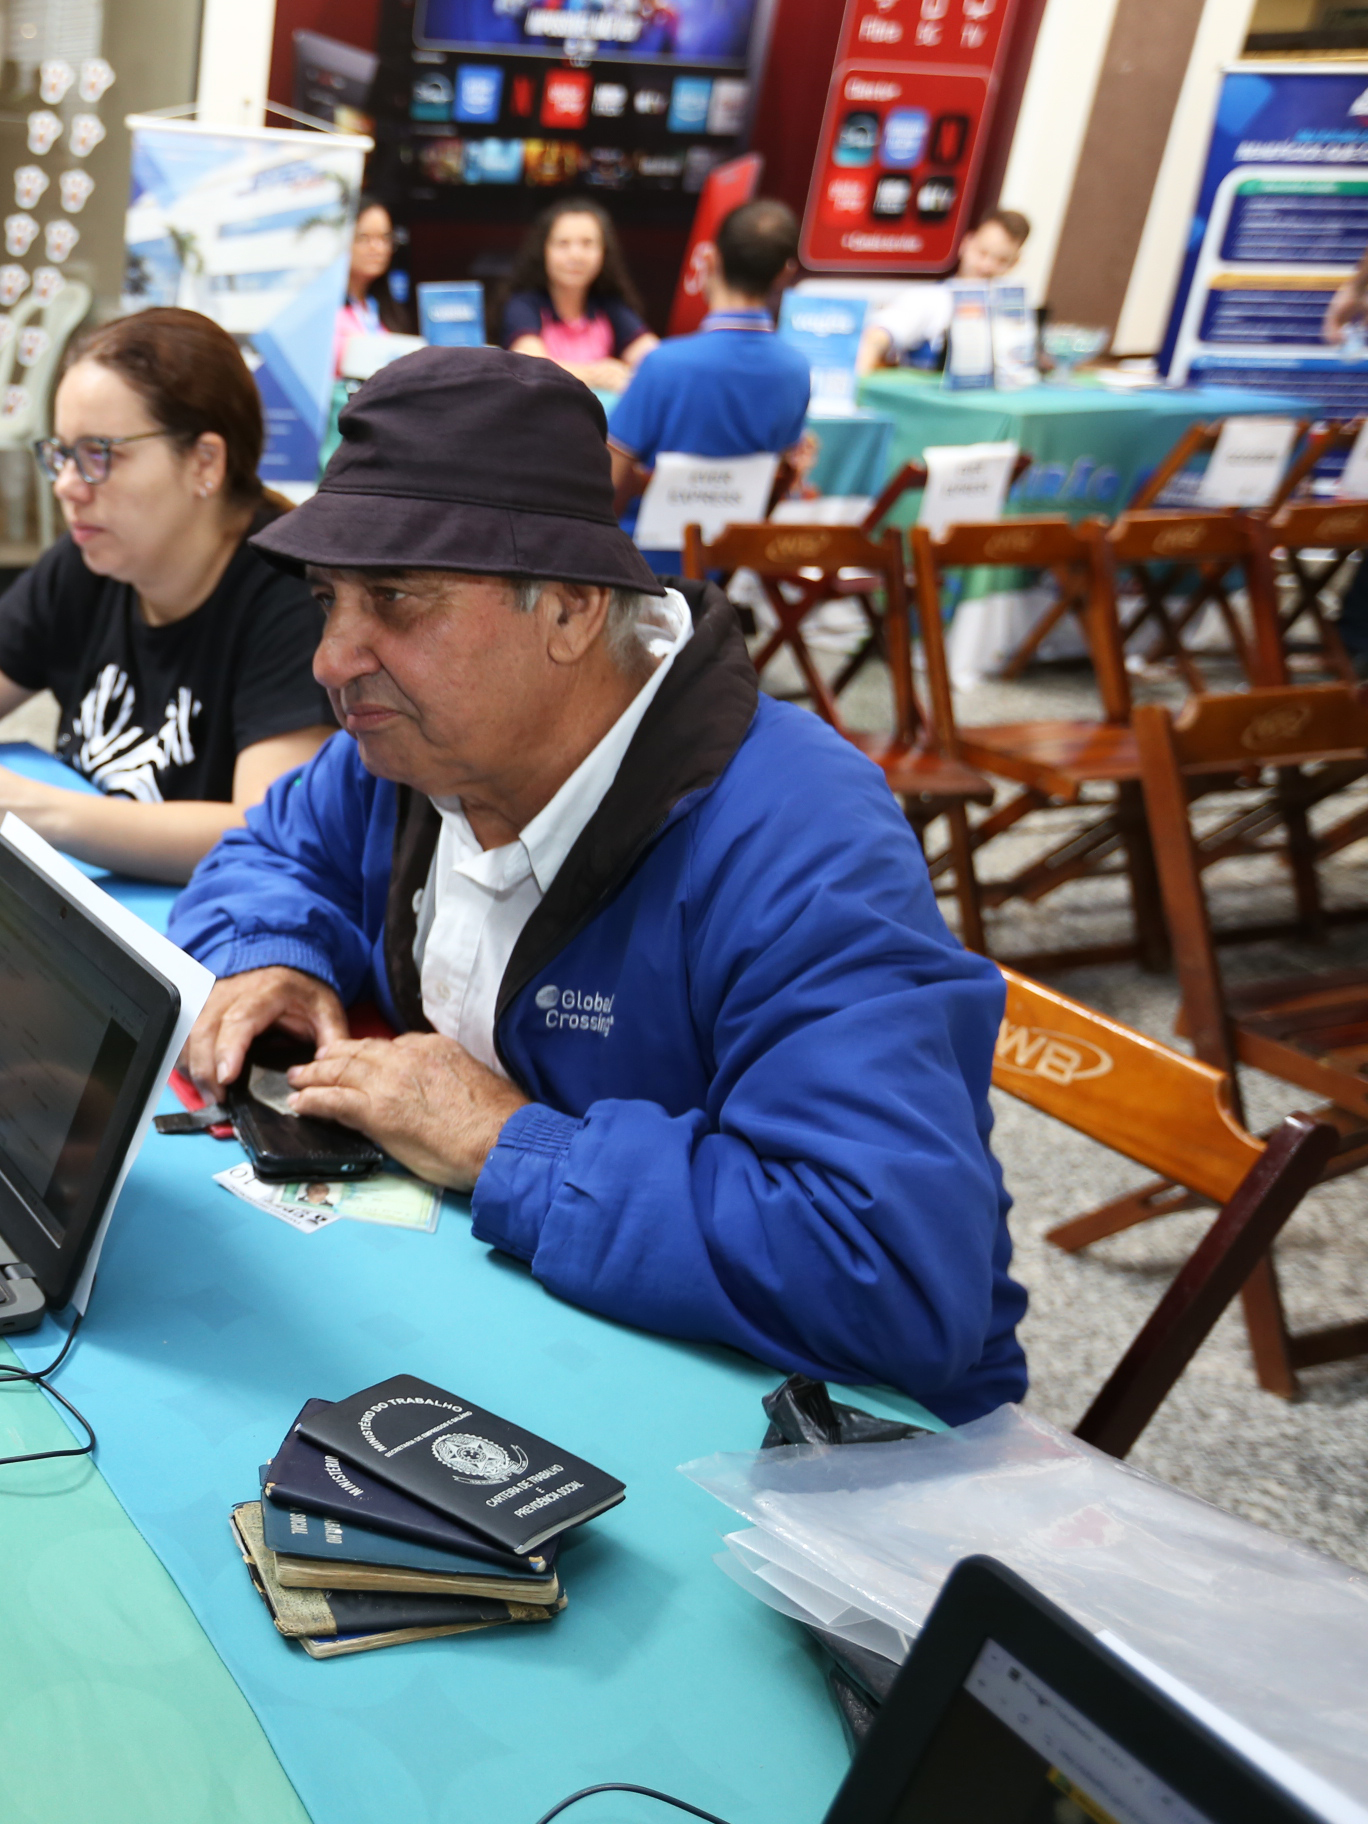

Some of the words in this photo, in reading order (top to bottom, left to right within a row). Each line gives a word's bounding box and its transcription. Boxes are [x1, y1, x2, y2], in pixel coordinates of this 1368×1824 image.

[561, 989, 615, 1014] Global
[995, 1017, 1082, 1087] WB
[370, 1402, 389, 1414] DO
[388, 1397, 463, 1413] TRABALHO
[358, 1410, 387, 1452] MINISTÉRIO
[485, 1486, 521, 1508] CARTEIRA
[520, 1479, 534, 1492] DE
[529, 1463, 564, 1484] TRABALHO
[513, 1491, 560, 1519] PREVIDÊNCIA
[556, 1480, 585, 1499] SOCIAL
